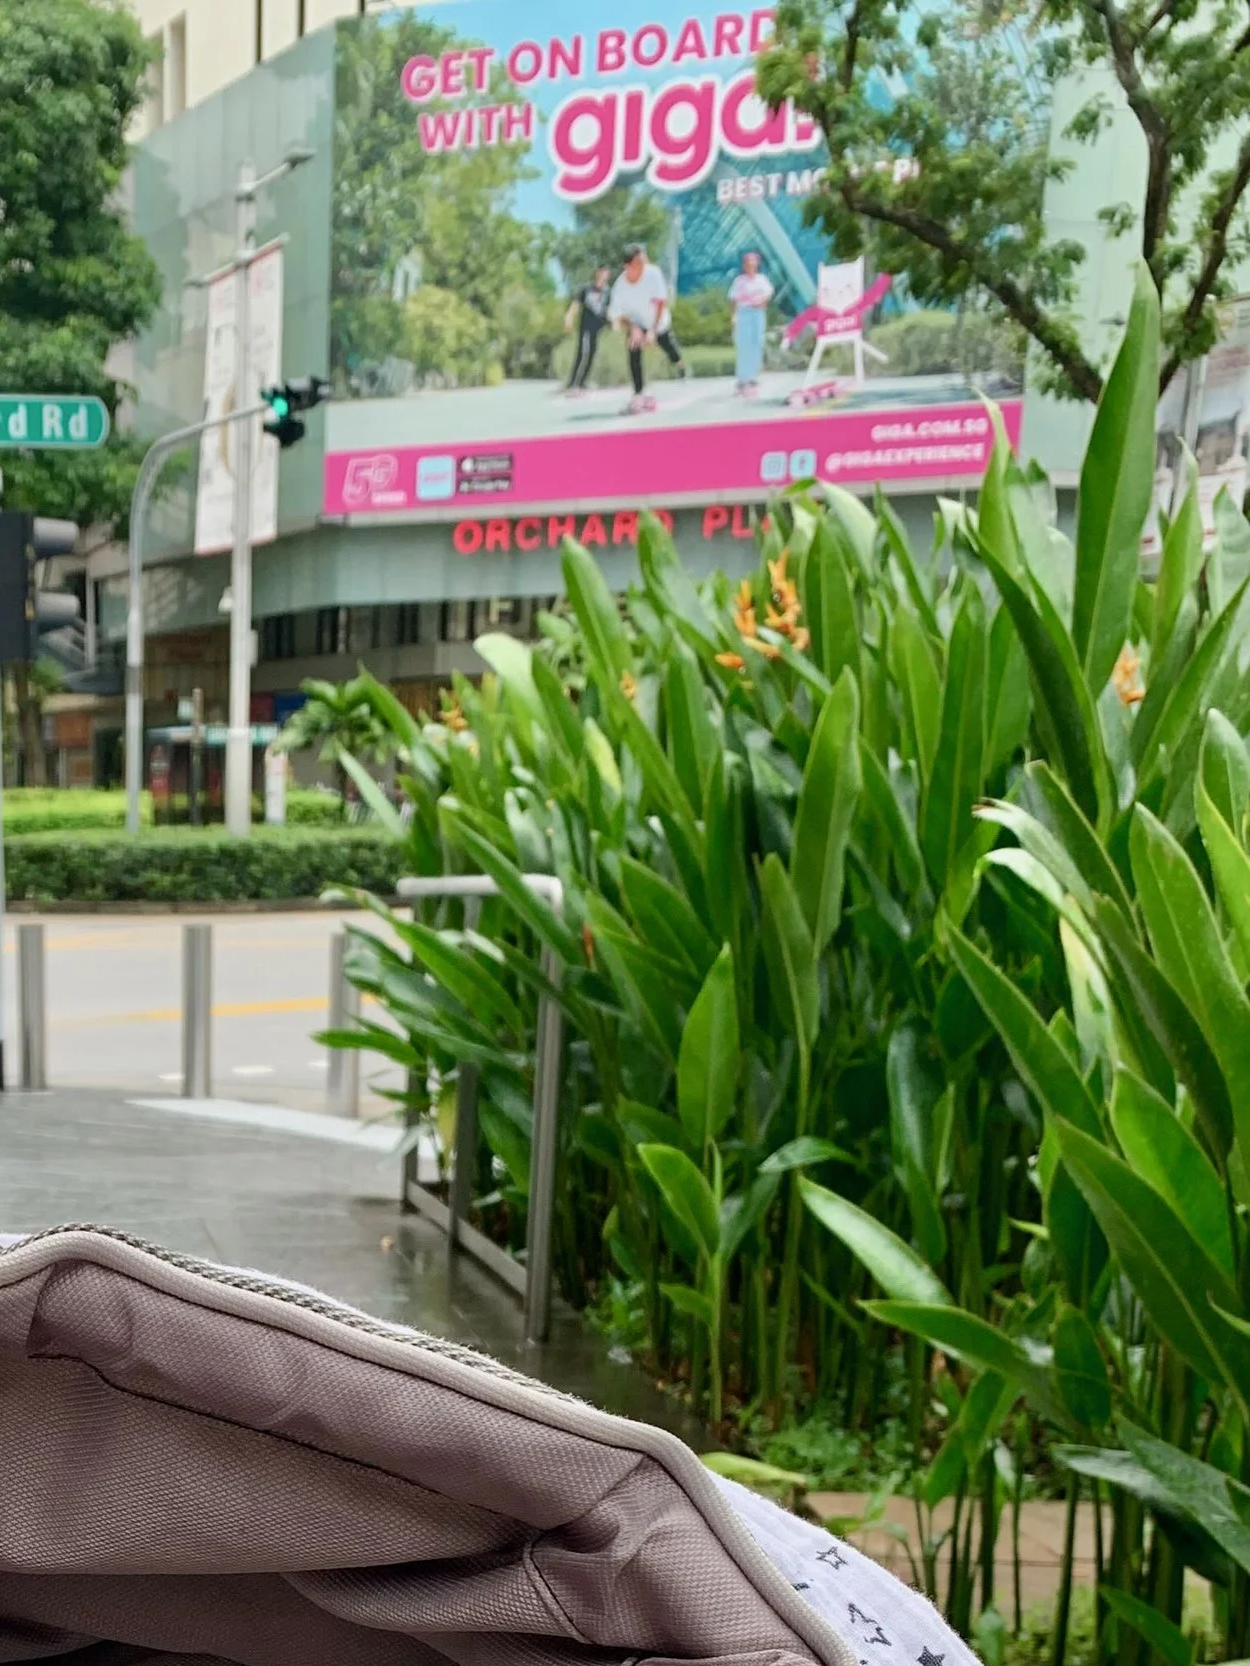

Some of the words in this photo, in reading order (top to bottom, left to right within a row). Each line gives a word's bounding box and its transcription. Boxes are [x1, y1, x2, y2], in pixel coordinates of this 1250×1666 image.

[400, 48, 496, 99] GET
[506, 33, 583, 85] ON
[419, 102, 534, 152] WITH
[716, 173, 782, 203] BEST
[41, 402, 89, 441] Rd
